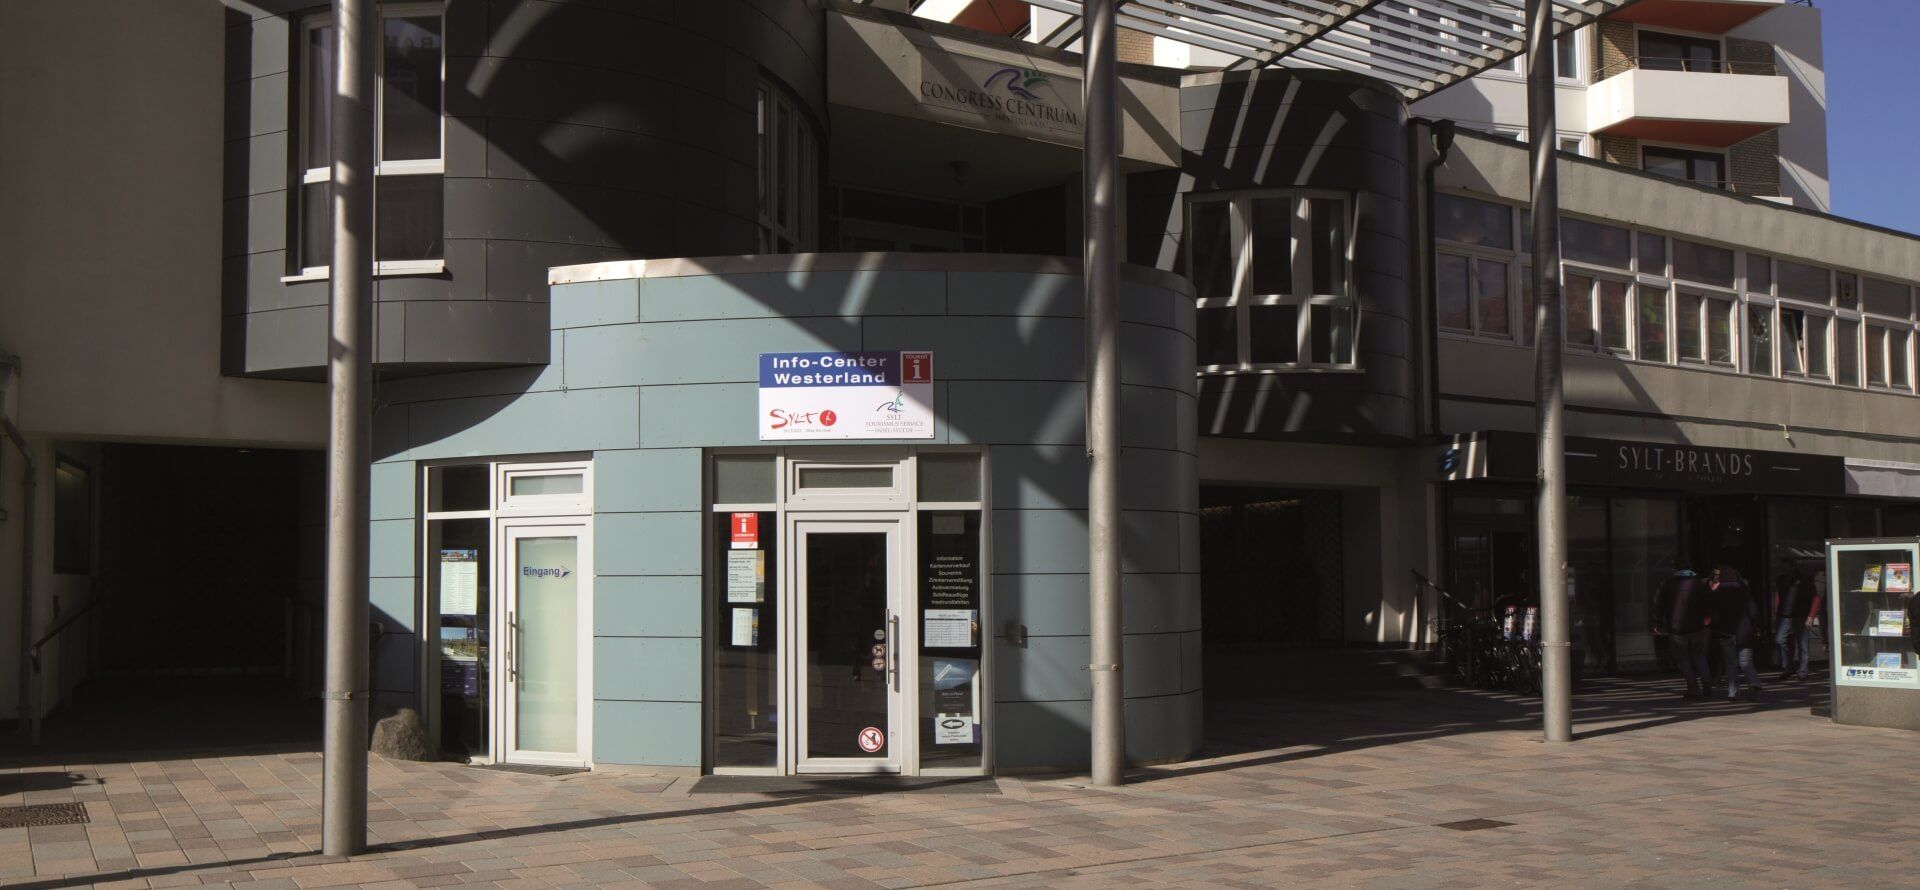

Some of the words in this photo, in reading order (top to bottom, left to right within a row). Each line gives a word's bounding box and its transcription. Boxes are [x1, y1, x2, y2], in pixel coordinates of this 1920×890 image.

[920, 81, 1002, 111] CONGRESS
[1006, 98, 1078, 126] CENTRUM
[773, 356, 887, 369] Info-Center
[774, 371, 886, 385] Westerland
[523, 566, 560, 578] Eingang
